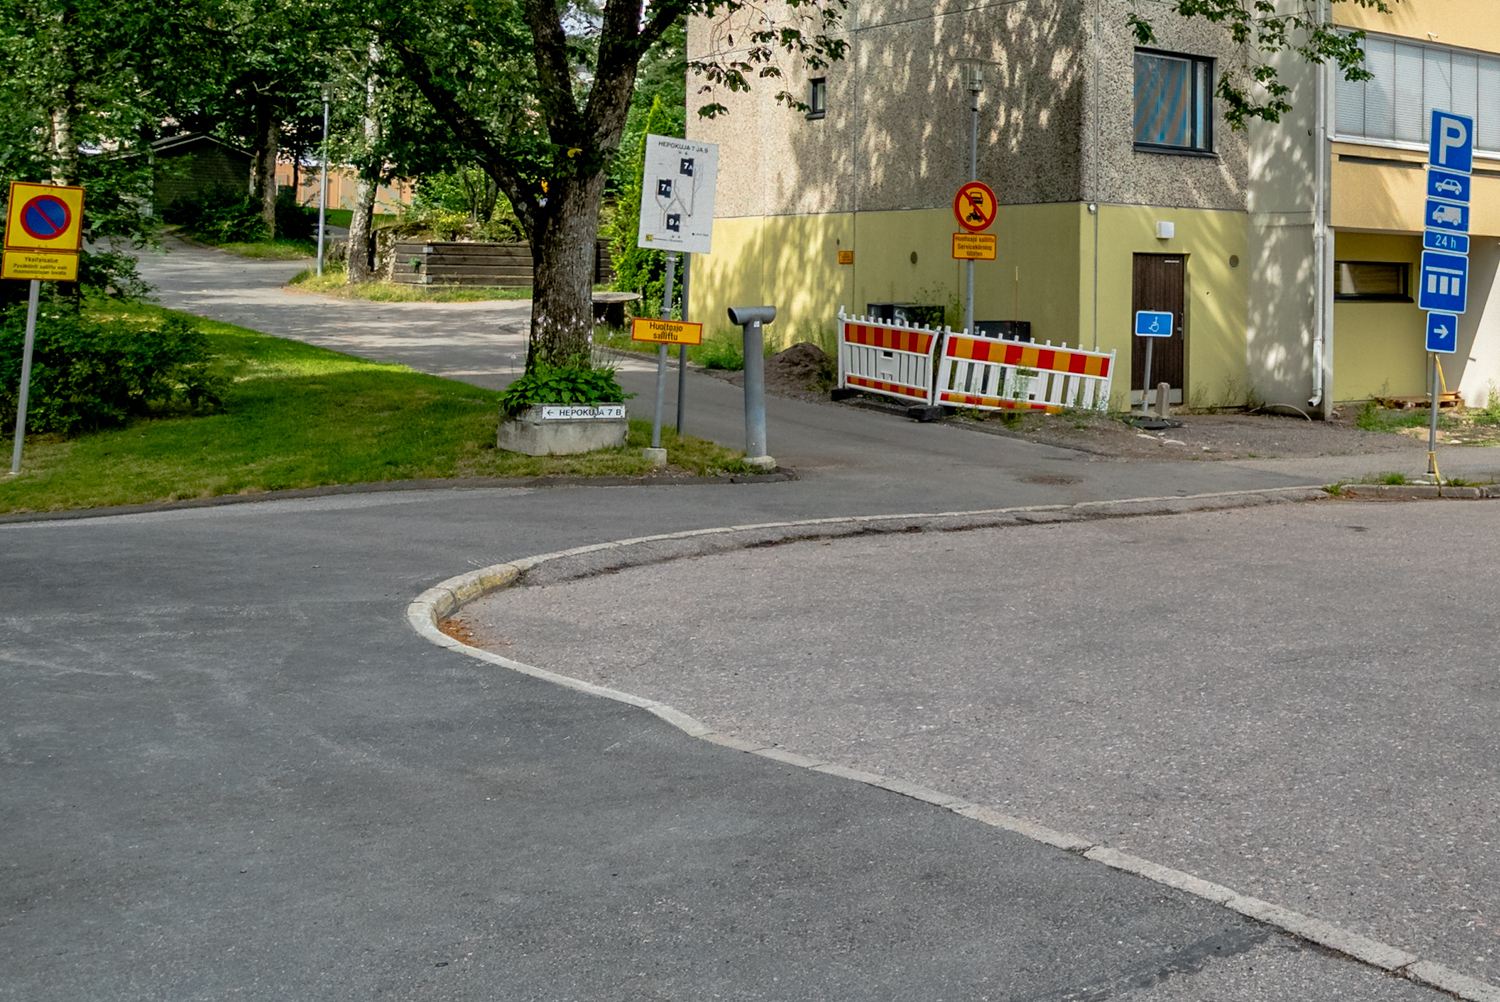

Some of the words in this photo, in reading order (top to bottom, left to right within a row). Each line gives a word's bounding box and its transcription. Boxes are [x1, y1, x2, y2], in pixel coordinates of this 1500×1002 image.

[1439, 116, 1467, 165] P
[658, 141, 691, 150] HEPOKUJA
[1435, 234, 1448, 247] 24
[1450, 236, 1457, 249] h
[649, 322, 683, 332] Huoltoajo
[653, 332, 678, 341] sallittu
[559, 408, 604, 416] HEPOKUJA
